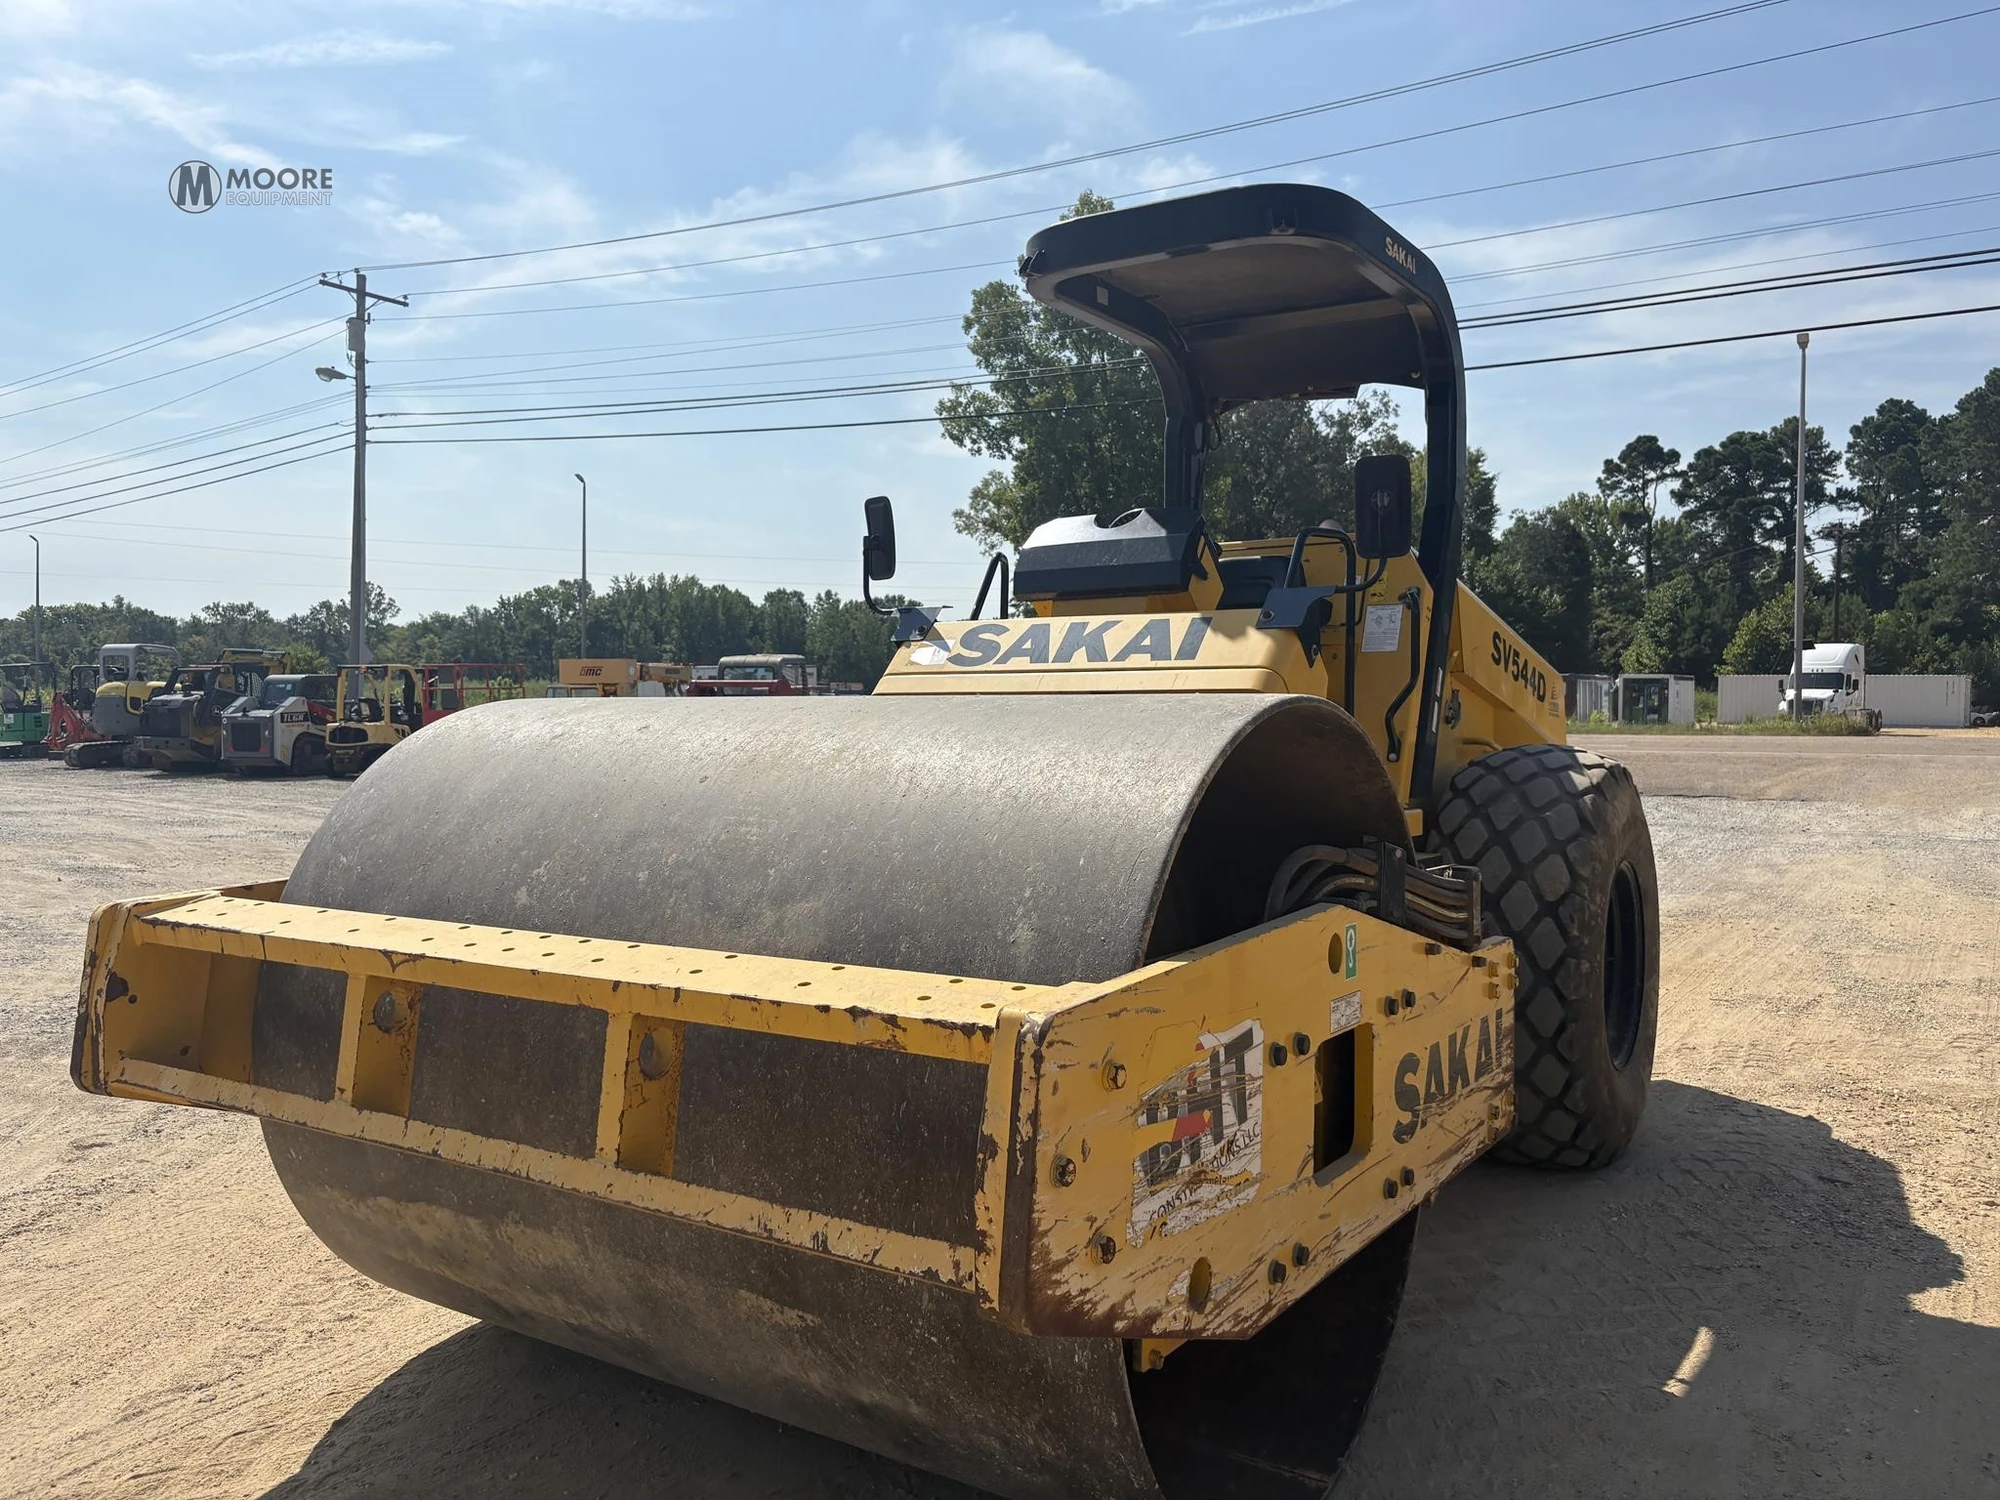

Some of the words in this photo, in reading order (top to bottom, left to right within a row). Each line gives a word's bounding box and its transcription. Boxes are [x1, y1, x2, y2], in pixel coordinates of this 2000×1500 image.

[1385, 236, 1416, 275] SAKAI
[946, 616, 1213, 667] SAKAI
[1490, 631, 1546, 703] SV544D
[1392, 1008, 1503, 1145] SAKAI
